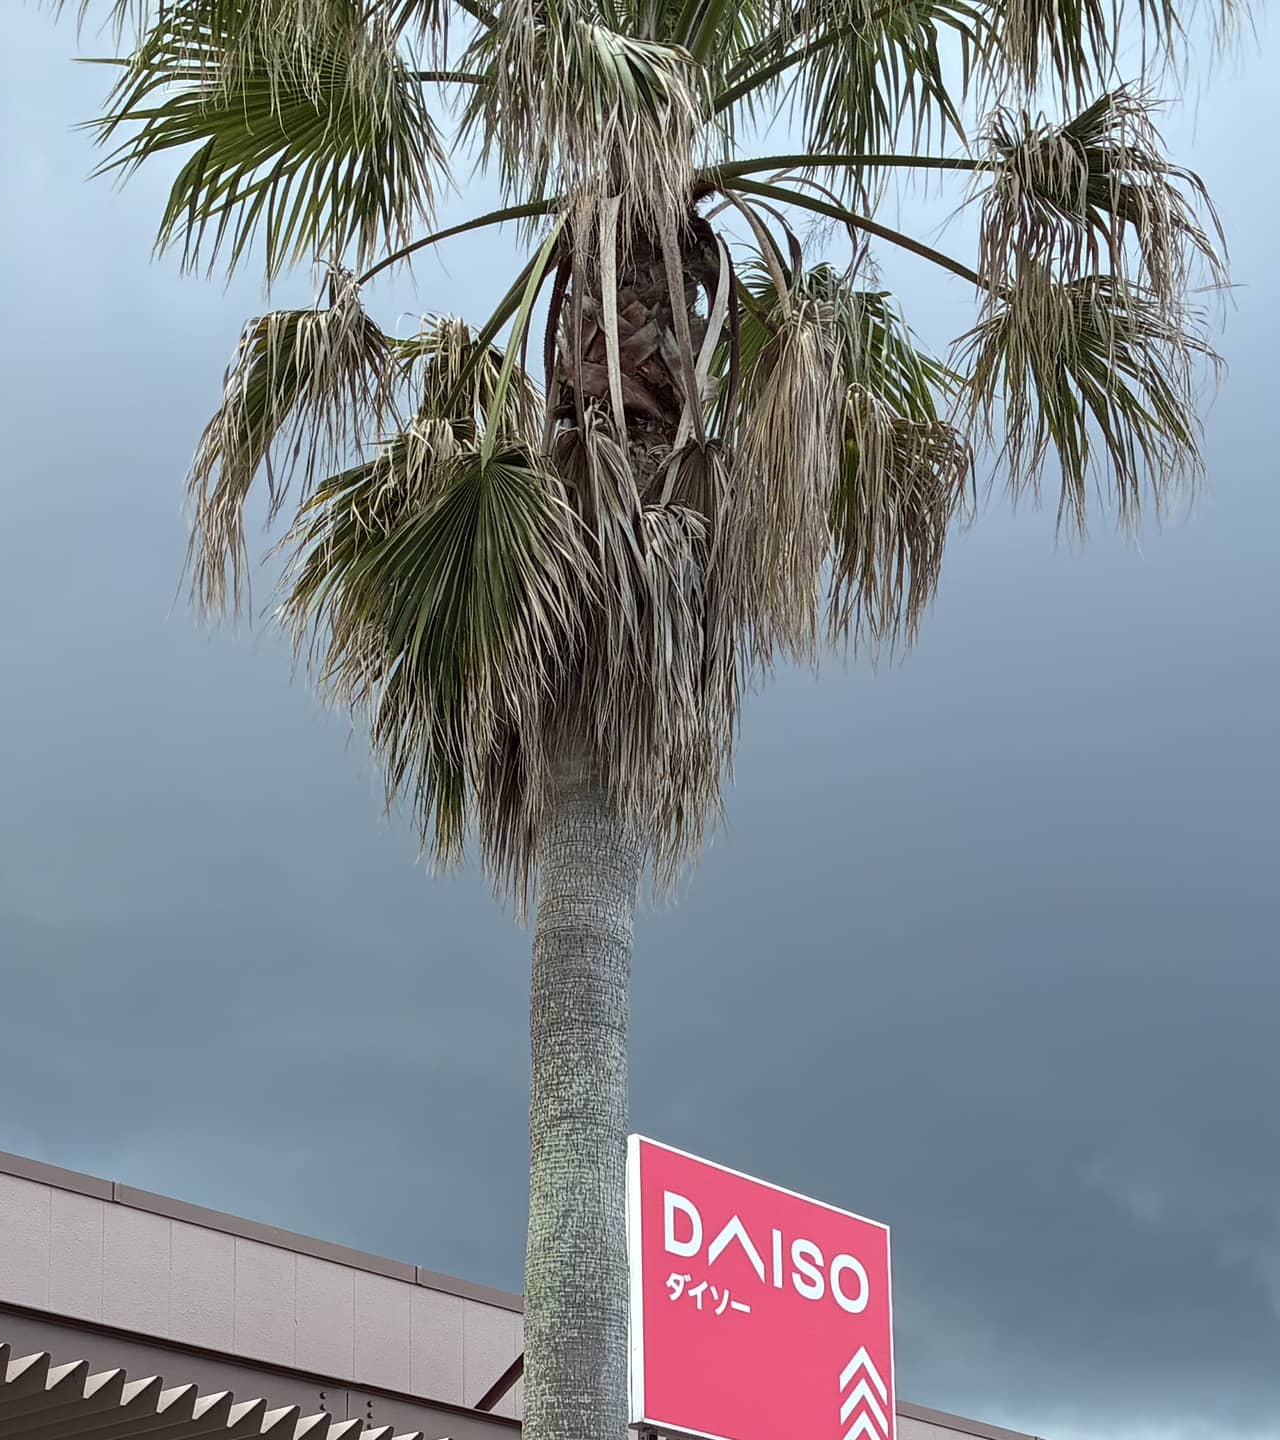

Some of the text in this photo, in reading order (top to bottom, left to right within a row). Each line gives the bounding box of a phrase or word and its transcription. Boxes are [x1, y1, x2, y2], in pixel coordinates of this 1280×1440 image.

[664, 1190, 869, 1313] DAISO
[666, 1272, 751, 1315] ダイソー
